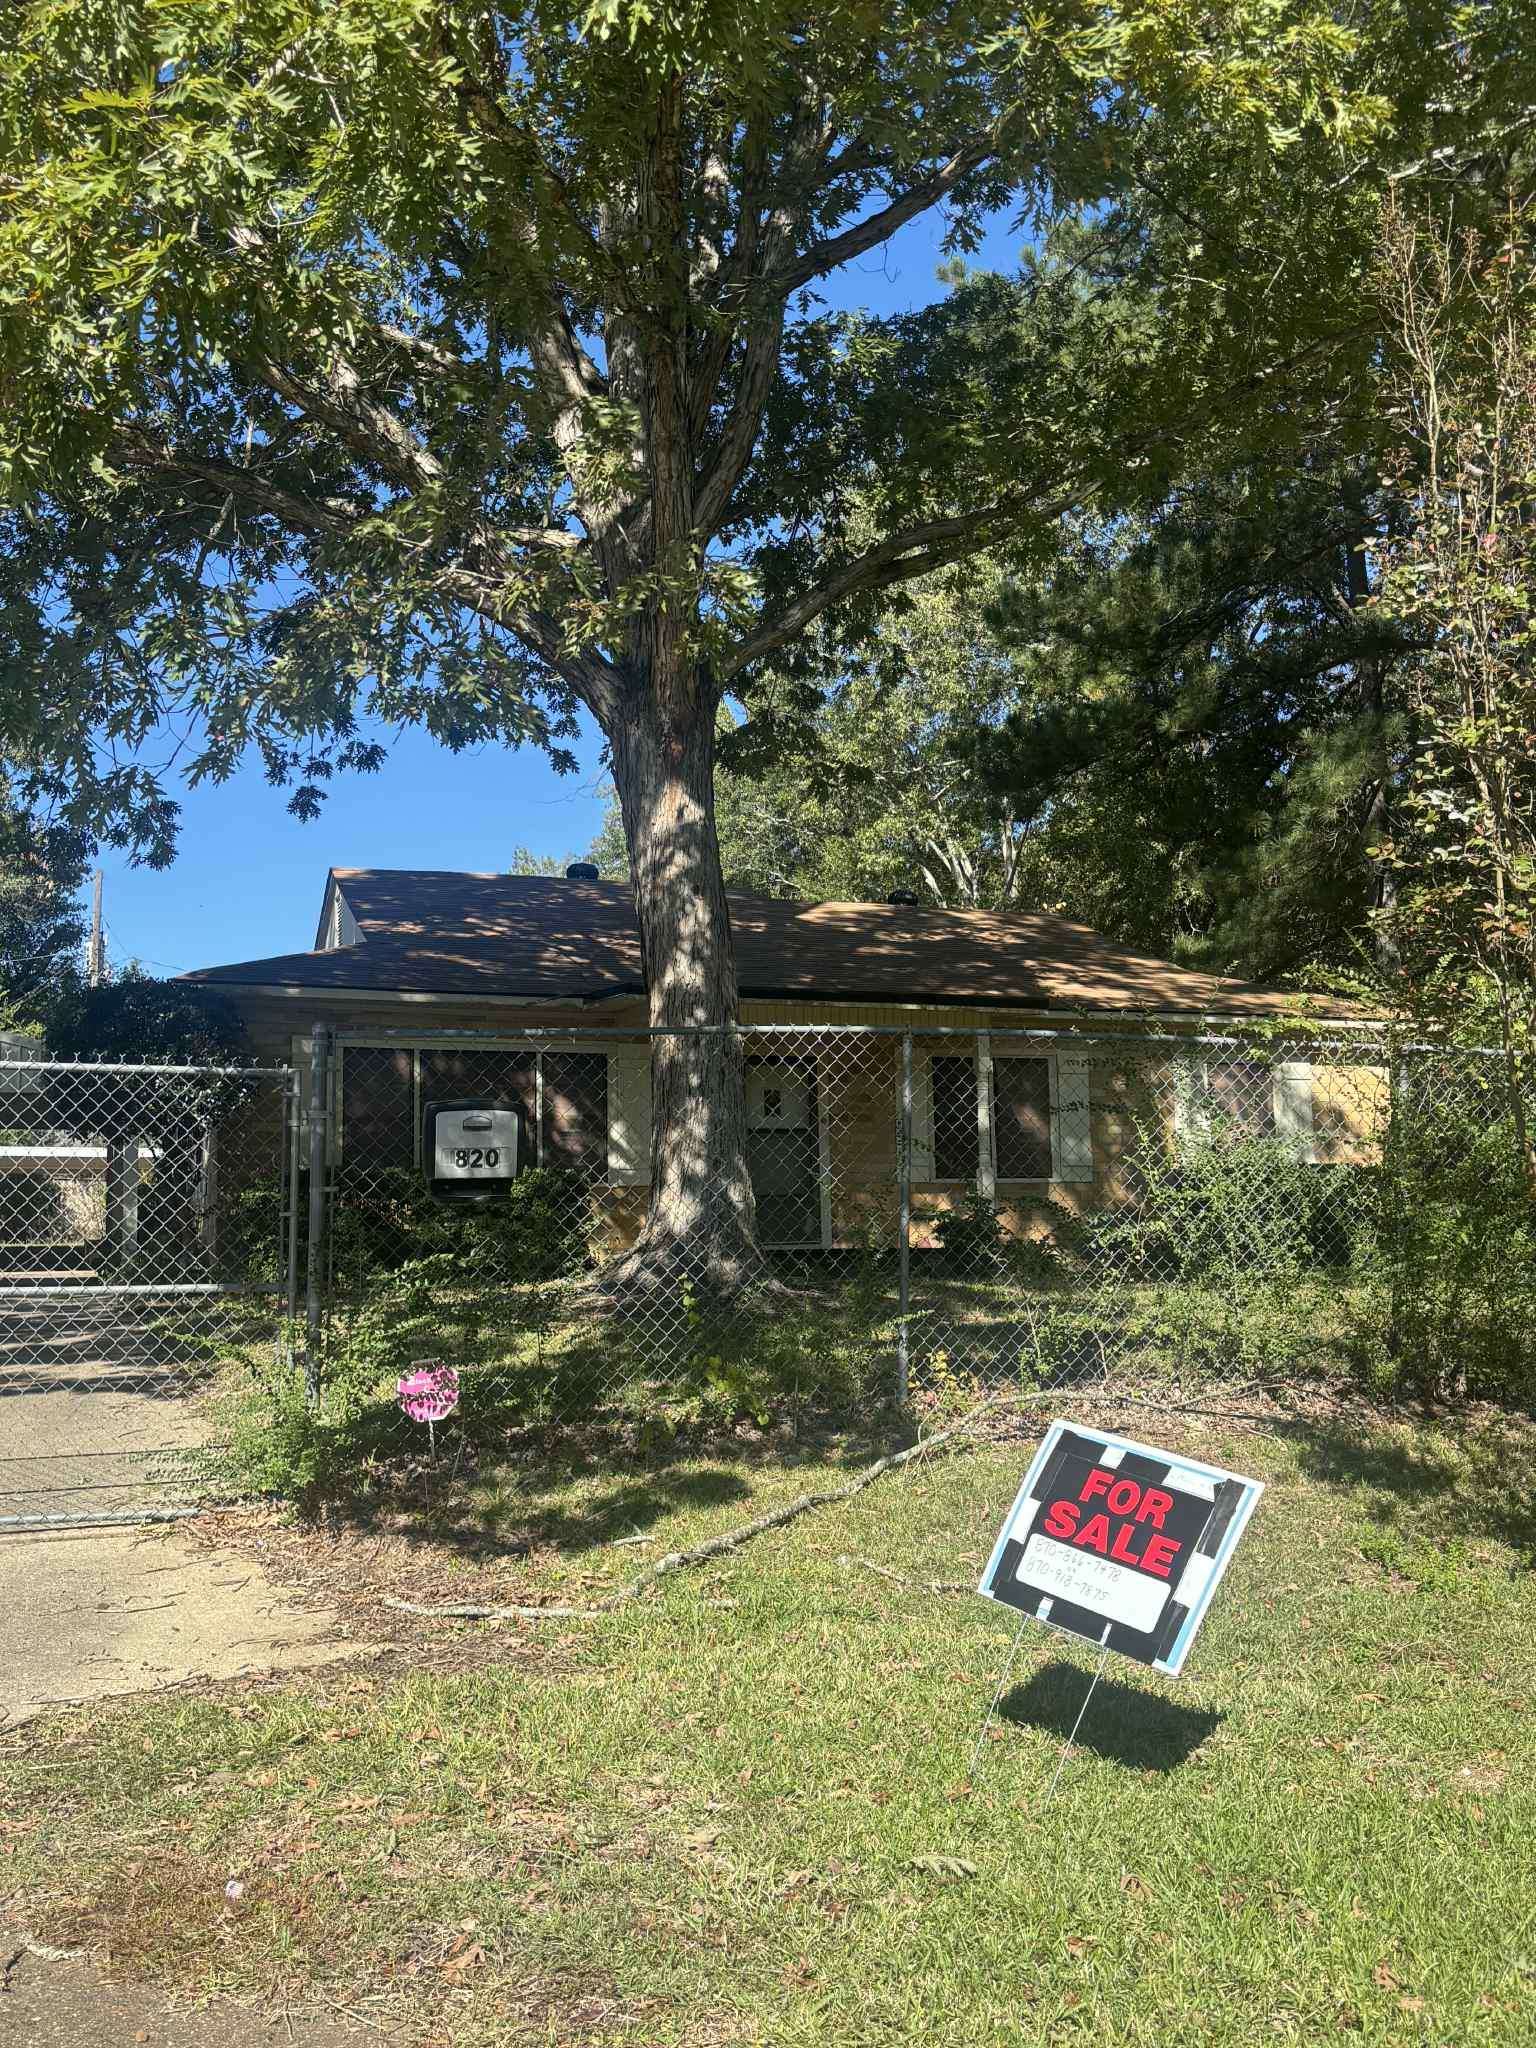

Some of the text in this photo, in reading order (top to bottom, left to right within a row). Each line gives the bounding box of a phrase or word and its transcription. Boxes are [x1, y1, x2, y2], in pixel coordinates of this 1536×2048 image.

[455, 1149, 499, 1168] 820
[1079, 1468, 1174, 1529] FOR
[1044, 1500, 1182, 1577] SALE
